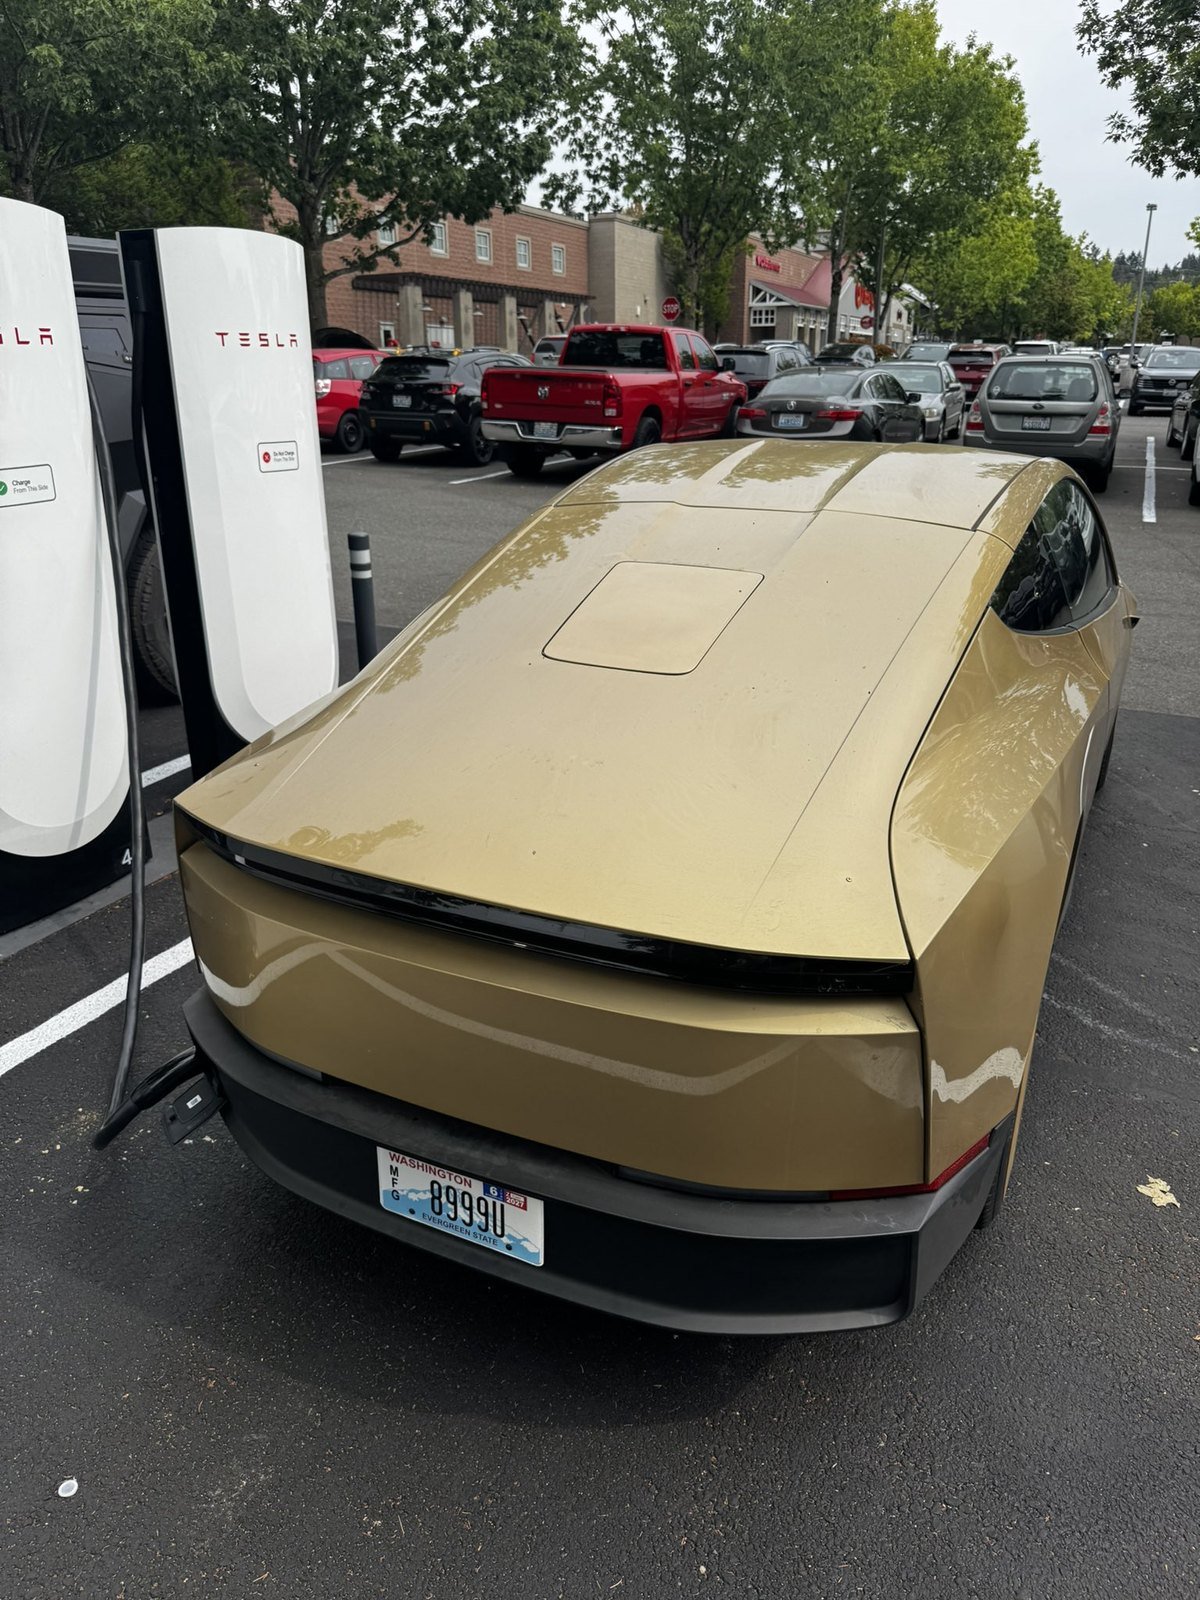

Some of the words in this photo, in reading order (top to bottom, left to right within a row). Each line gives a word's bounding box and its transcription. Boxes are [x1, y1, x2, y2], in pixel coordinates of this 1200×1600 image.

[663, 304, 679, 314] STOP
[0, 327, 54, 345] LA
[215, 332, 299, 348] TESLA
[121, 848, 133, 865] 4
[389, 1152, 472, 1189] WASHINGTON
[489, 1186, 498, 1196] 6
[430, 1180, 505, 1239] 8999U
[506, 1198, 525, 1208] 2027
[422, 1212, 471, 1236] EVERGREEN
[472, 1231, 498, 1246] STATE
